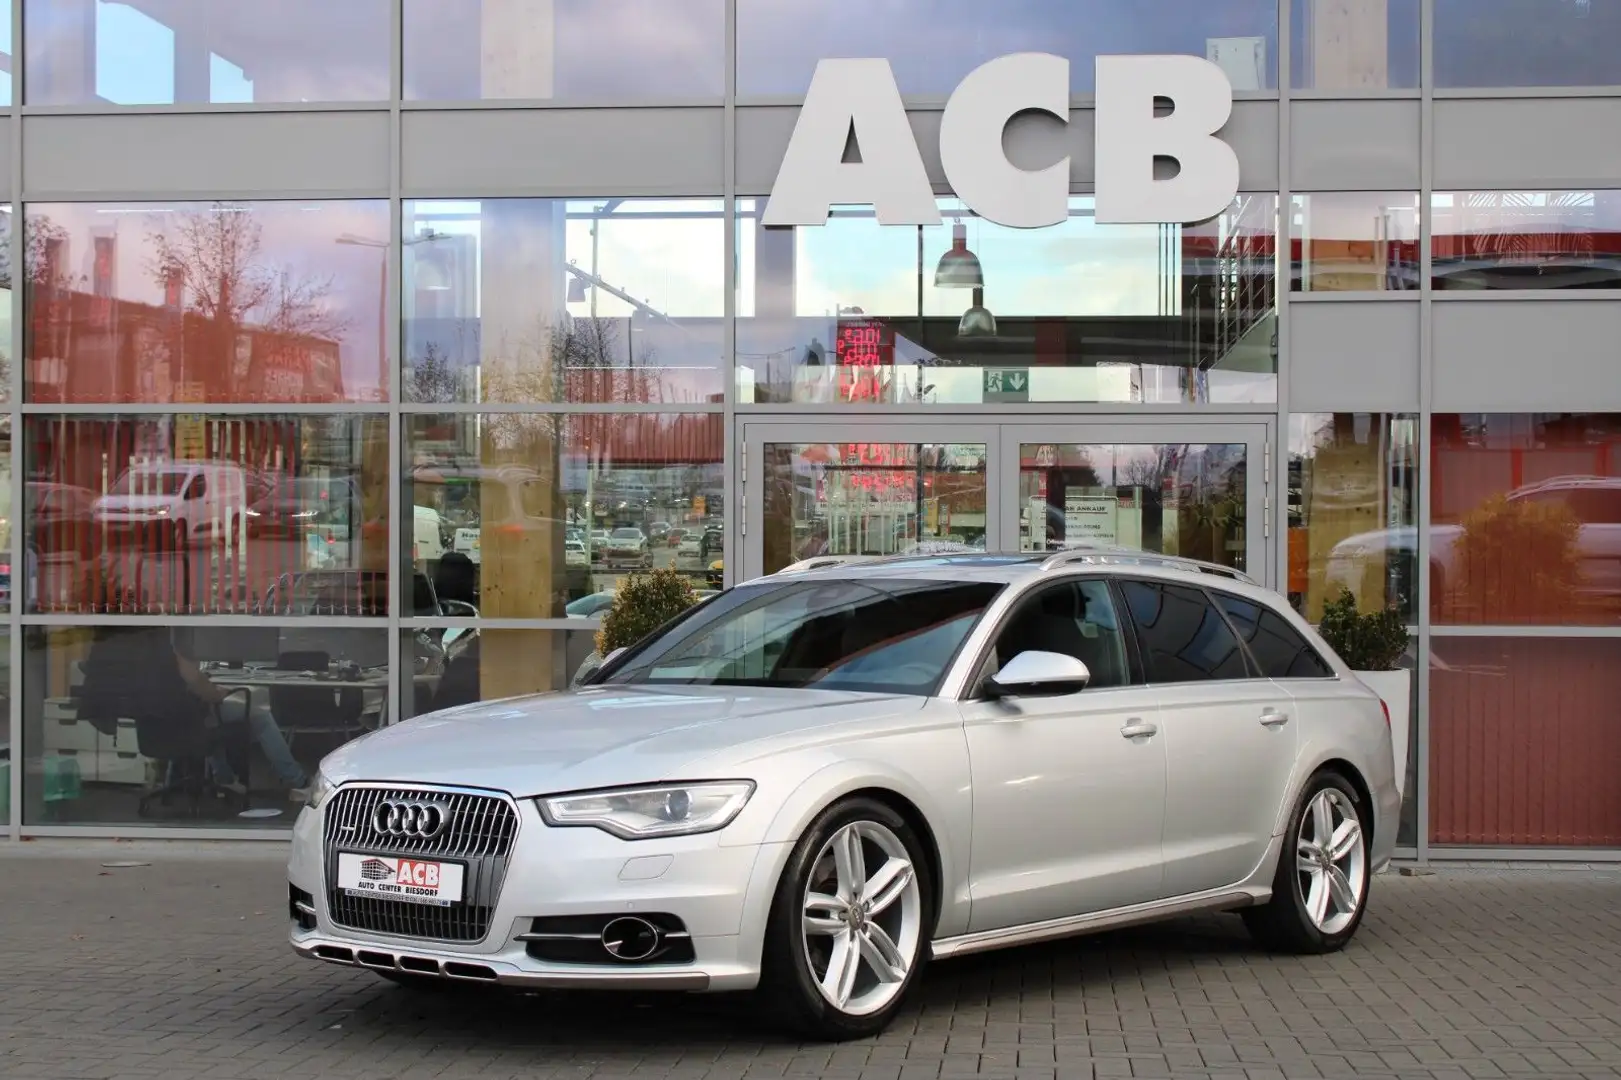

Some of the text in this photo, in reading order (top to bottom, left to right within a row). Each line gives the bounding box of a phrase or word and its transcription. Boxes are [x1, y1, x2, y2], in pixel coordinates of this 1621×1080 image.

[762, 52, 1240, 227] ACB
[397, 861, 439, 886] ACB
[358, 881, 439, 897] AUTO CENTER BIESDORF
